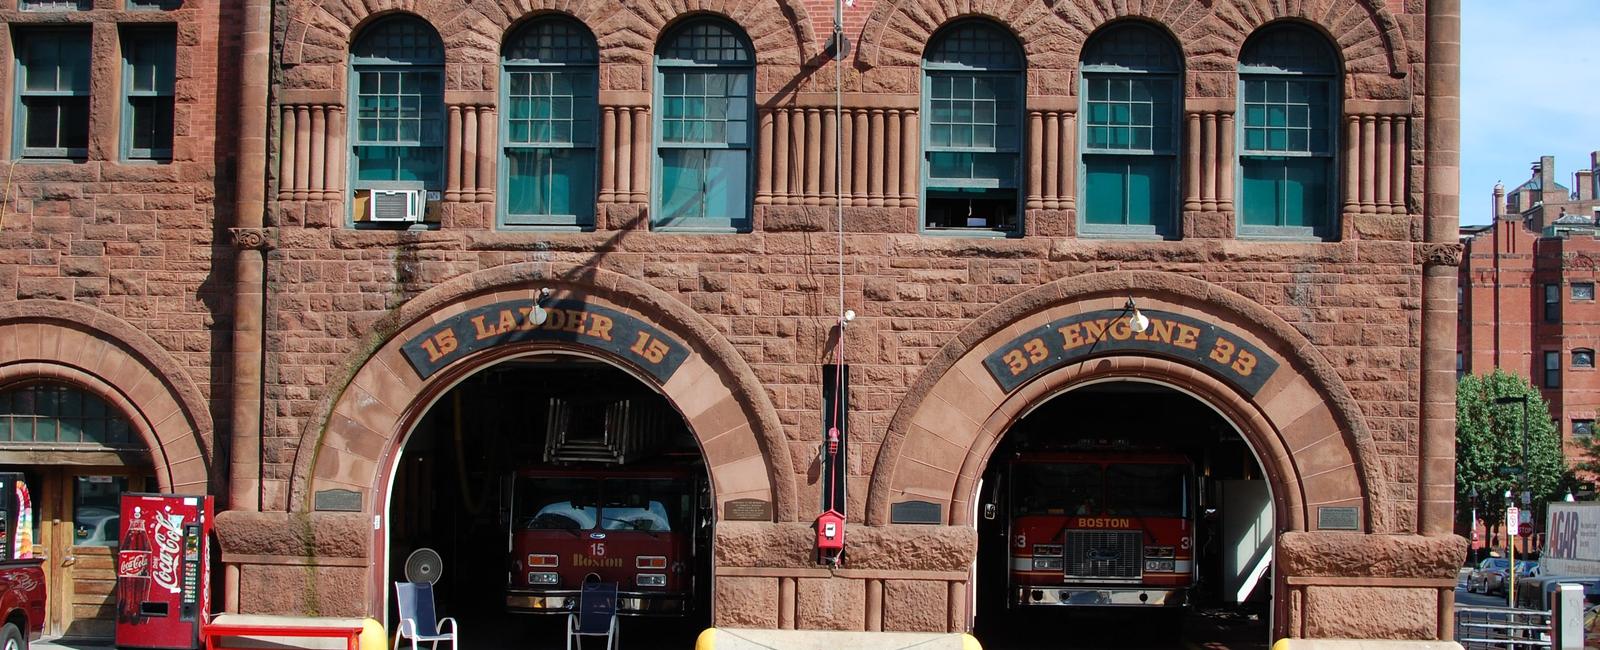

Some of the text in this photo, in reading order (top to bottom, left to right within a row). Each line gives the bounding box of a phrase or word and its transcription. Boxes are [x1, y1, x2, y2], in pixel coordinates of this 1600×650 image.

[420, 327, 459, 363] 15
[630, 330, 670, 364] 15
[1002, 337, 1049, 376] 33
[1209, 336, 1257, 377] 33
[1078, 518, 1129, 528] BOSTON
[1549, 511, 1579, 560] AGAR
[153, 510, 180, 589] Coca-Col
[590, 543, 605, 556] 15
